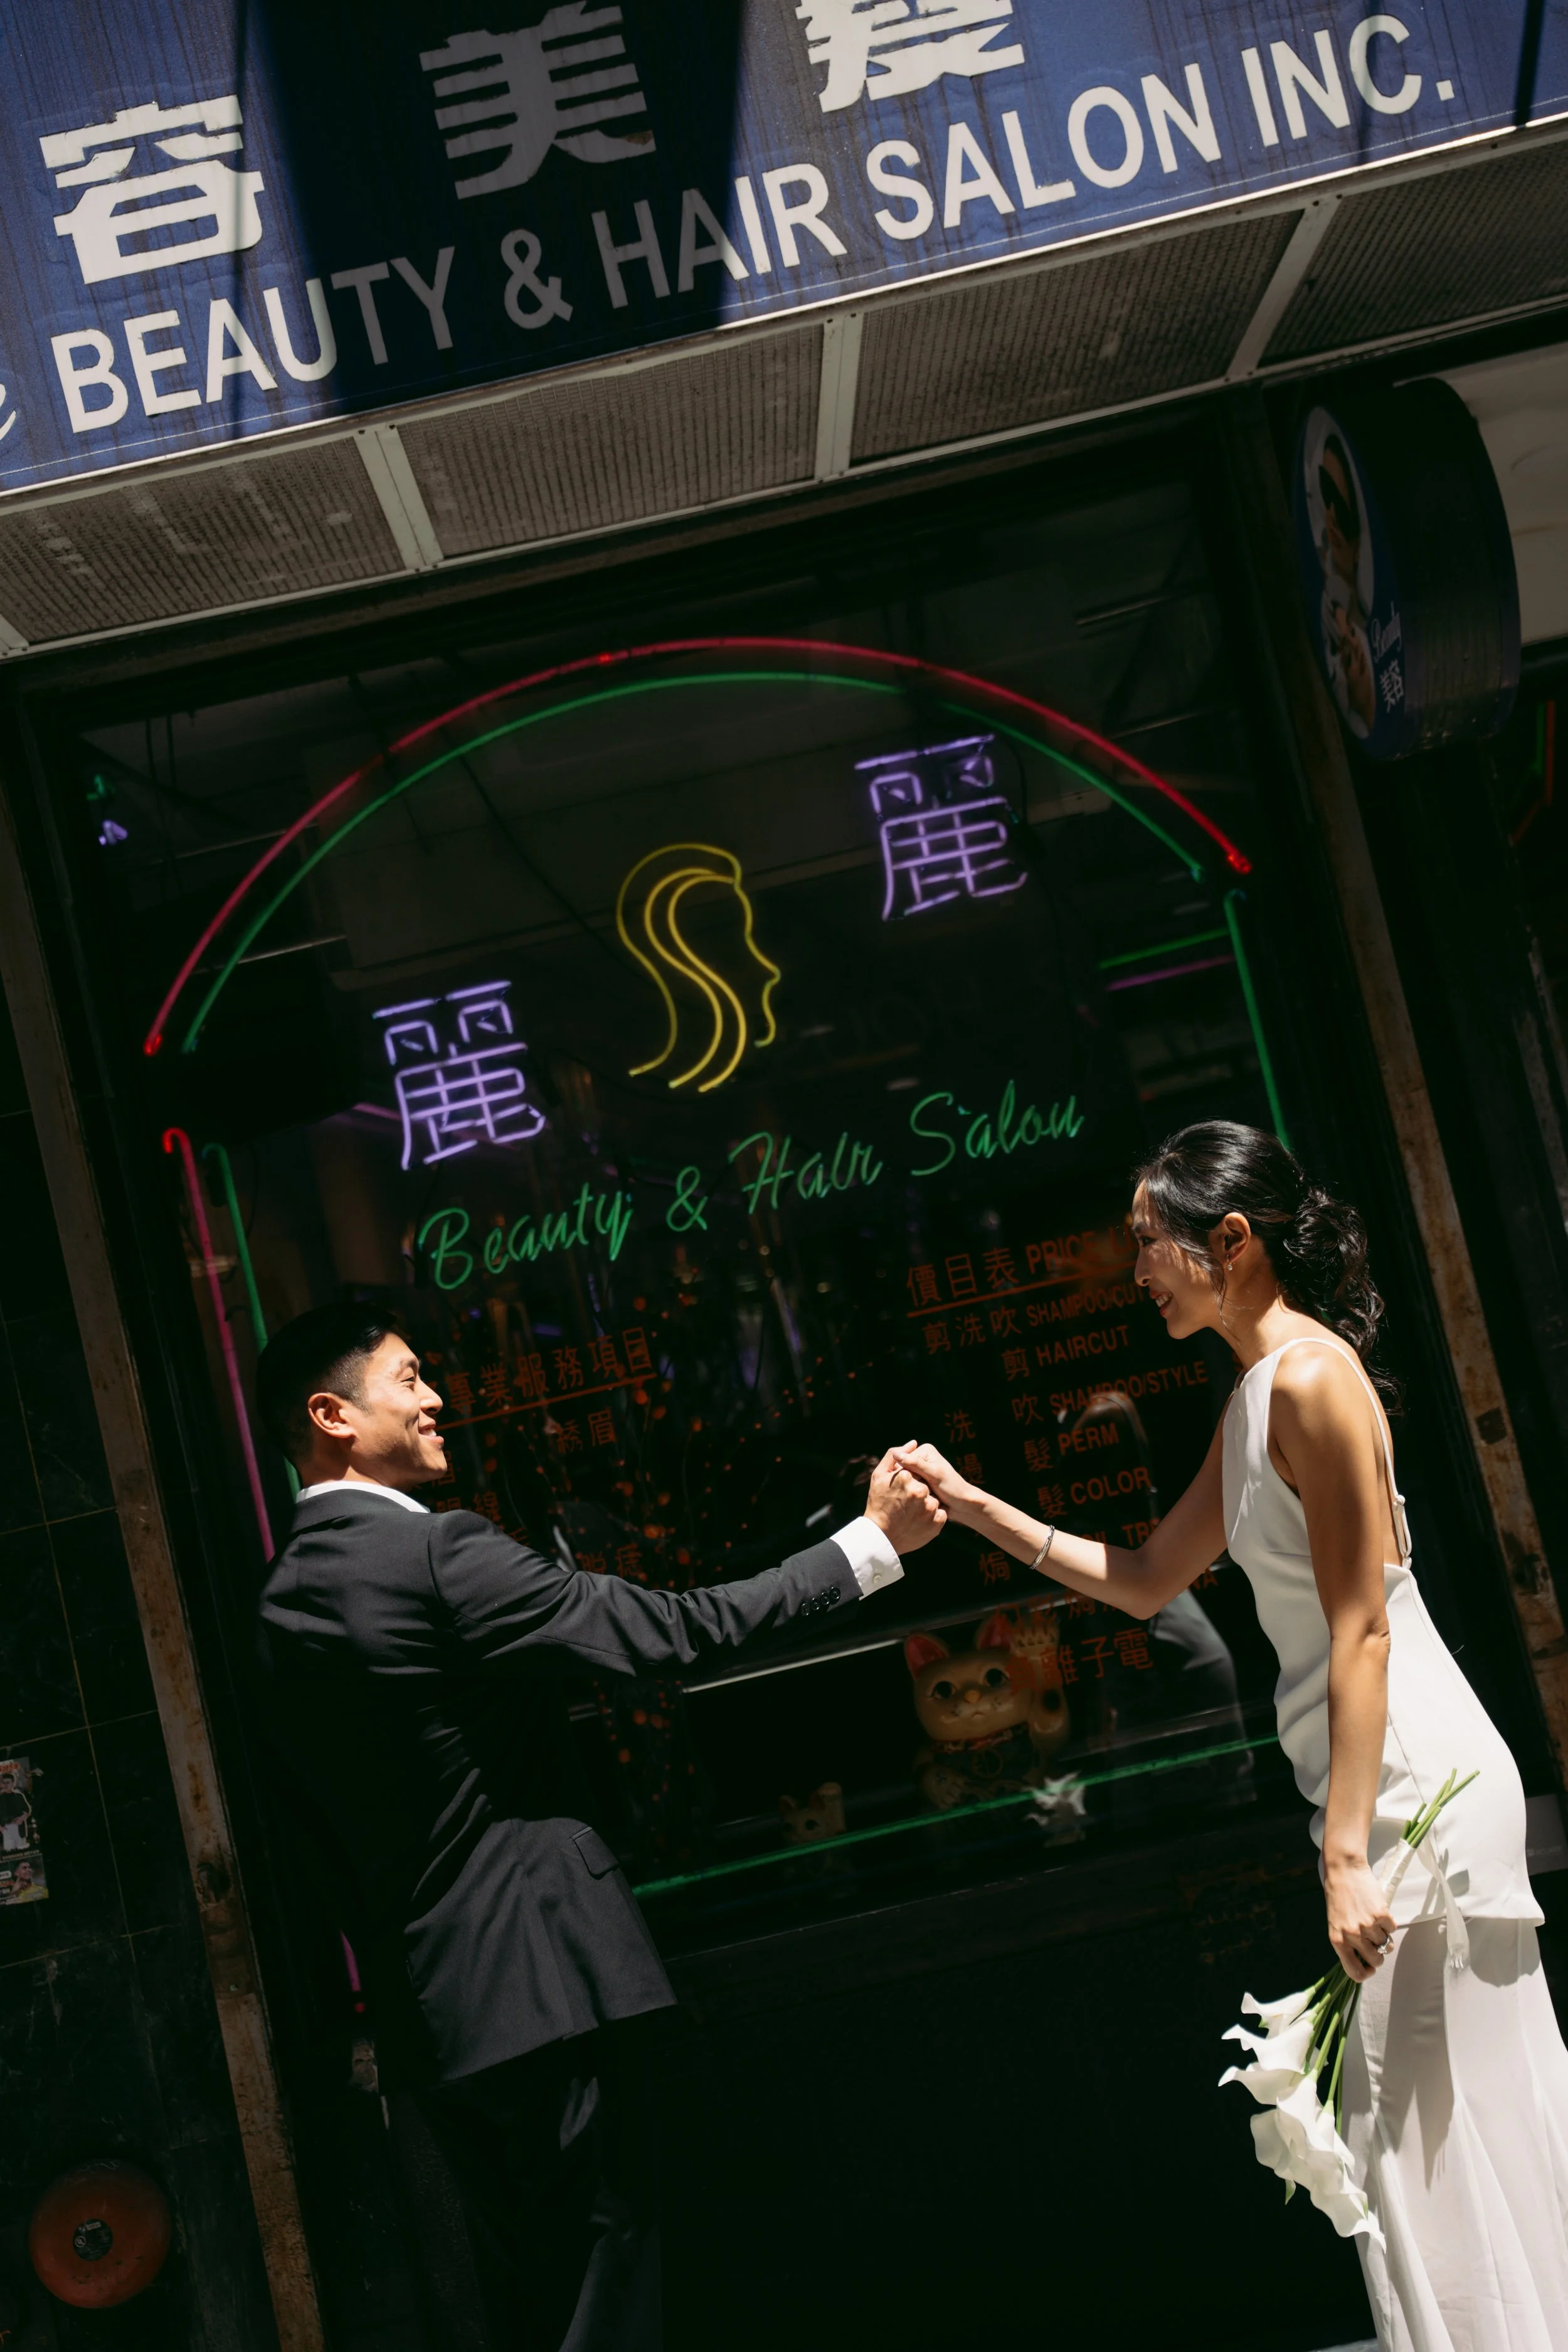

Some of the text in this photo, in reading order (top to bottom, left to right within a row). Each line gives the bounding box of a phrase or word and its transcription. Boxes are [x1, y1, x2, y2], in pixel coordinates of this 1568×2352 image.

[50, 246, 455, 433] BEAUTY
[501, 229, 574, 331] &
[591, 163, 847, 308] HAIR
[866, 64, 1222, 241] SALON
[1241, 14, 1454, 147] INC.
[418, 1078, 1085, 1291] Beauty & Hair Salon
[906, 1246, 1020, 1308] 價目表
[1024, 1229, 1101, 1275] PRICE
[921, 1305, 1022, 1355] 剪洗吹
[1034, 1324, 1131, 1368] HAIRCUT
[1049, 1360, 1209, 1417] SHAMPOO/STYLE
[1057, 1422, 1120, 1456] PERM
[1069, 1466, 1153, 1506] COLOR
